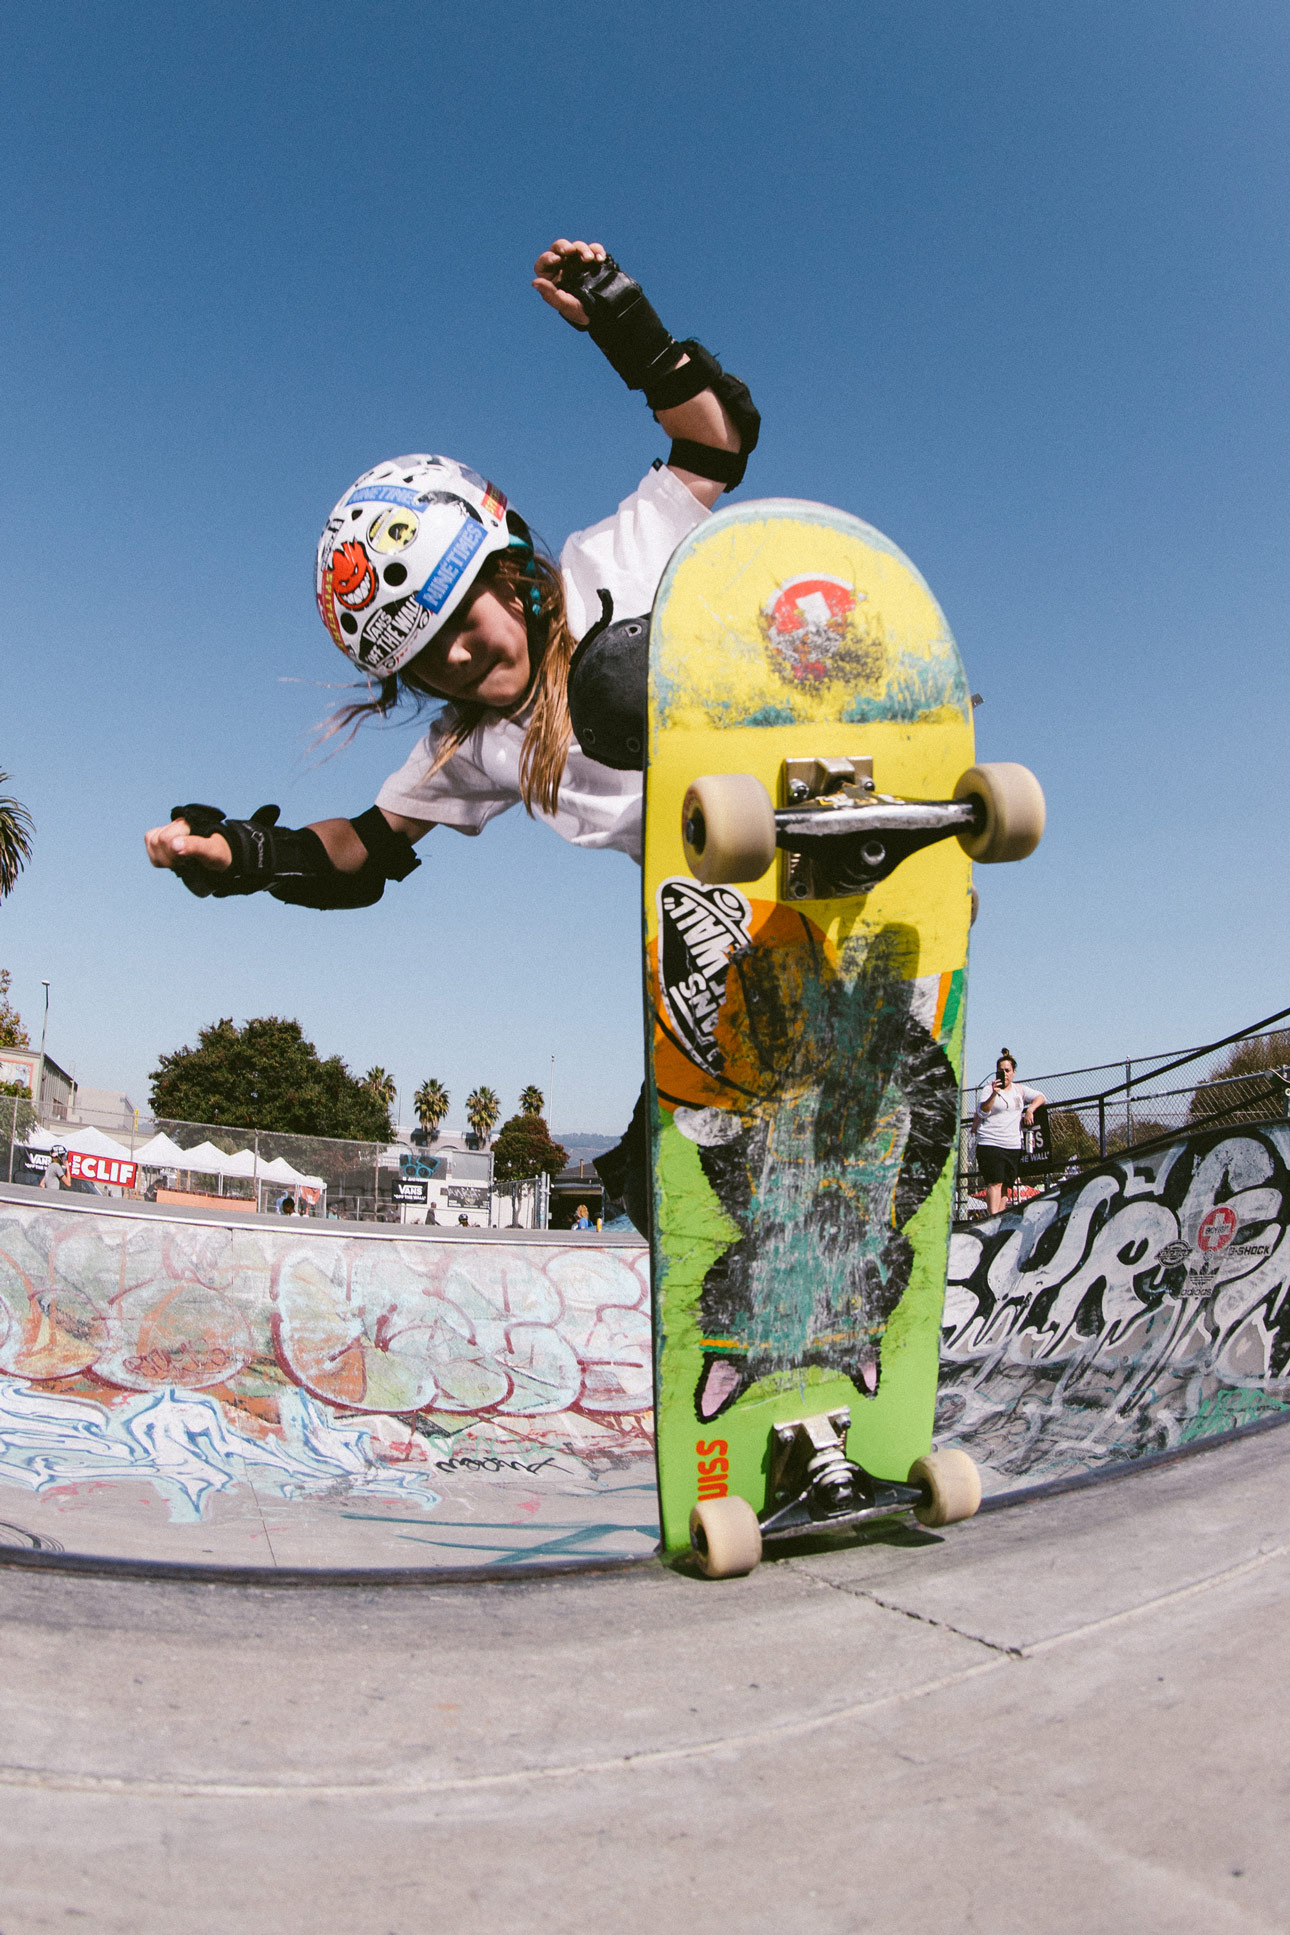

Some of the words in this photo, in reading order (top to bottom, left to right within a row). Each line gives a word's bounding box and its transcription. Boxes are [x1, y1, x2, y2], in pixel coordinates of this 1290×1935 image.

[422, 523, 483, 607] NINETIMES
[363, 608, 392, 643] VANS
[376, 625, 404, 653] THE
[71, 1155, 81, 1175] BAR
[81, 1158, 134, 1184] CLIF
[398, 1184, 423, 1196] VANS
[1228, 1245, 1270, 1256] G-SHOCK
